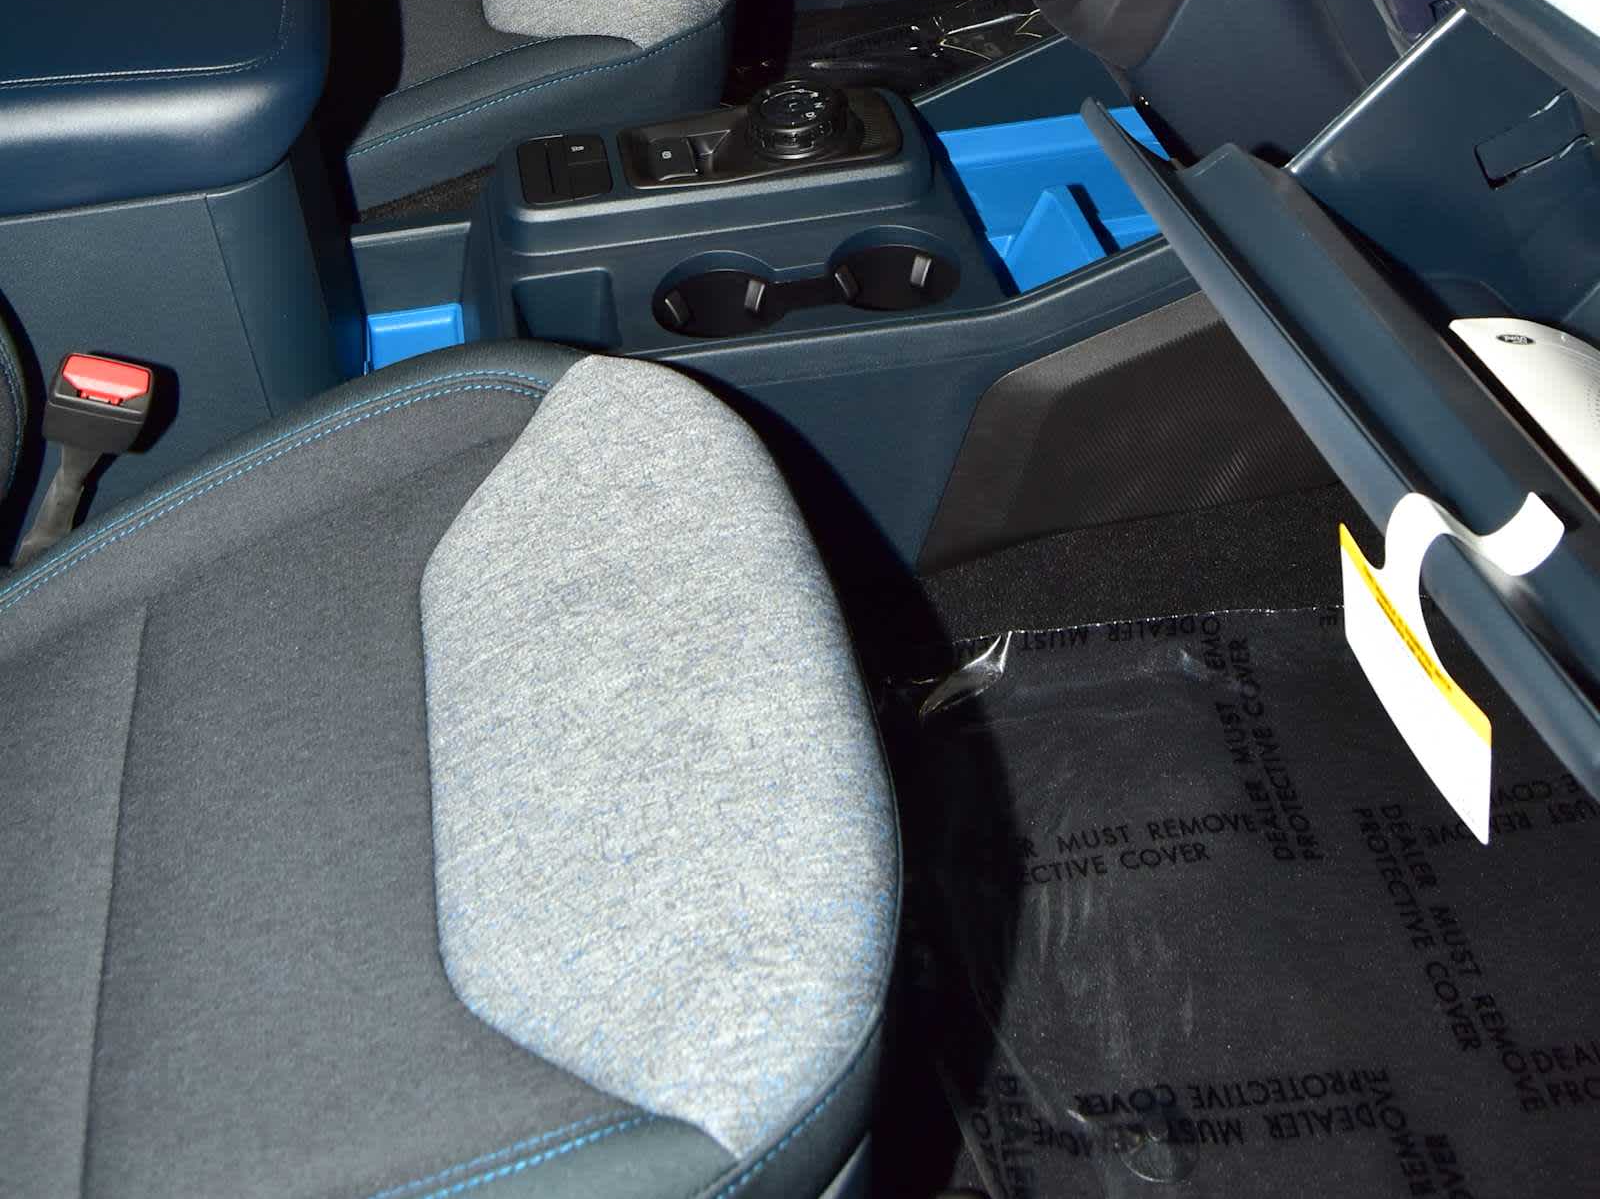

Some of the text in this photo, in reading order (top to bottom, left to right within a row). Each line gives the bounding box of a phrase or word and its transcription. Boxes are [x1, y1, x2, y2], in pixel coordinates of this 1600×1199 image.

[1020, 627, 1090, 651] MUST
[1106, 614, 1197, 643] DEALER
[1213, 701, 1254, 765] MUST
[1228, 636, 1324, 863] PROTECTIVE COVER
[1056, 824, 1130, 853] MUST
[1145, 809, 1258, 841] REMOVE
[1244, 779, 1296, 863] DEALER
[1547, 797, 1598, 825] UST
[1118, 841, 1212, 871] COVER
[1352, 807, 1483, 1052] PROTECTIVE COVER
[1380, 804, 1547, 1113] DEALER MUST REMOVE
[1074, 1070, 1365, 1117] PROTECTIVE COVER
[1164, 1116, 1245, 1147] MUST
[1265, 1103, 1378, 1141] DEALER
